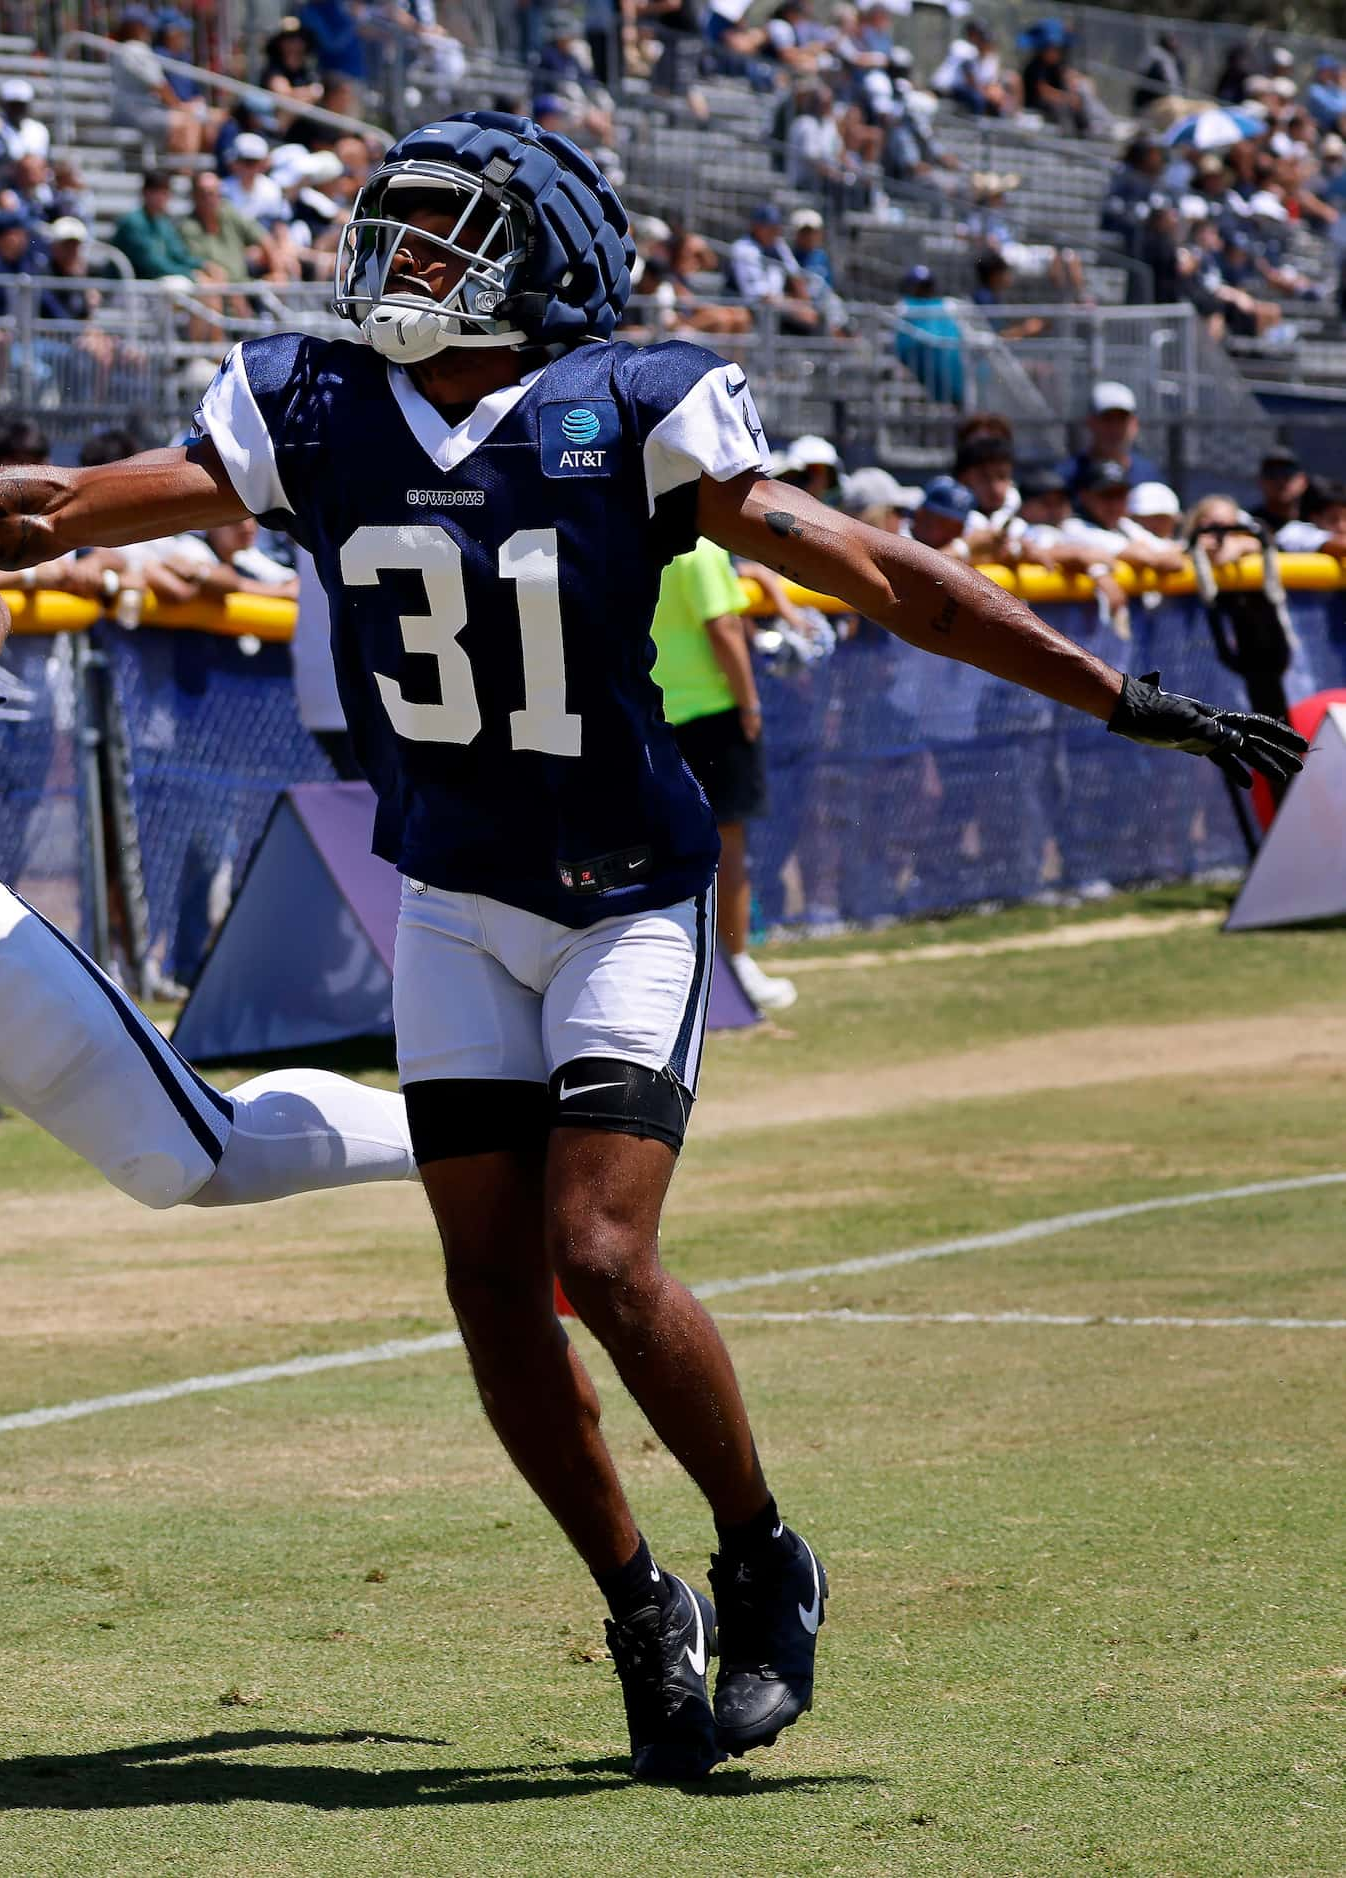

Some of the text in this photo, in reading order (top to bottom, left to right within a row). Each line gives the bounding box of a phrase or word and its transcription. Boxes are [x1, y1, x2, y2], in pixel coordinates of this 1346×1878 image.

[559, 450, 606, 468] AT&T
[407, 489, 484, 505] COWBOYS
[340, 525, 582, 757] 31
